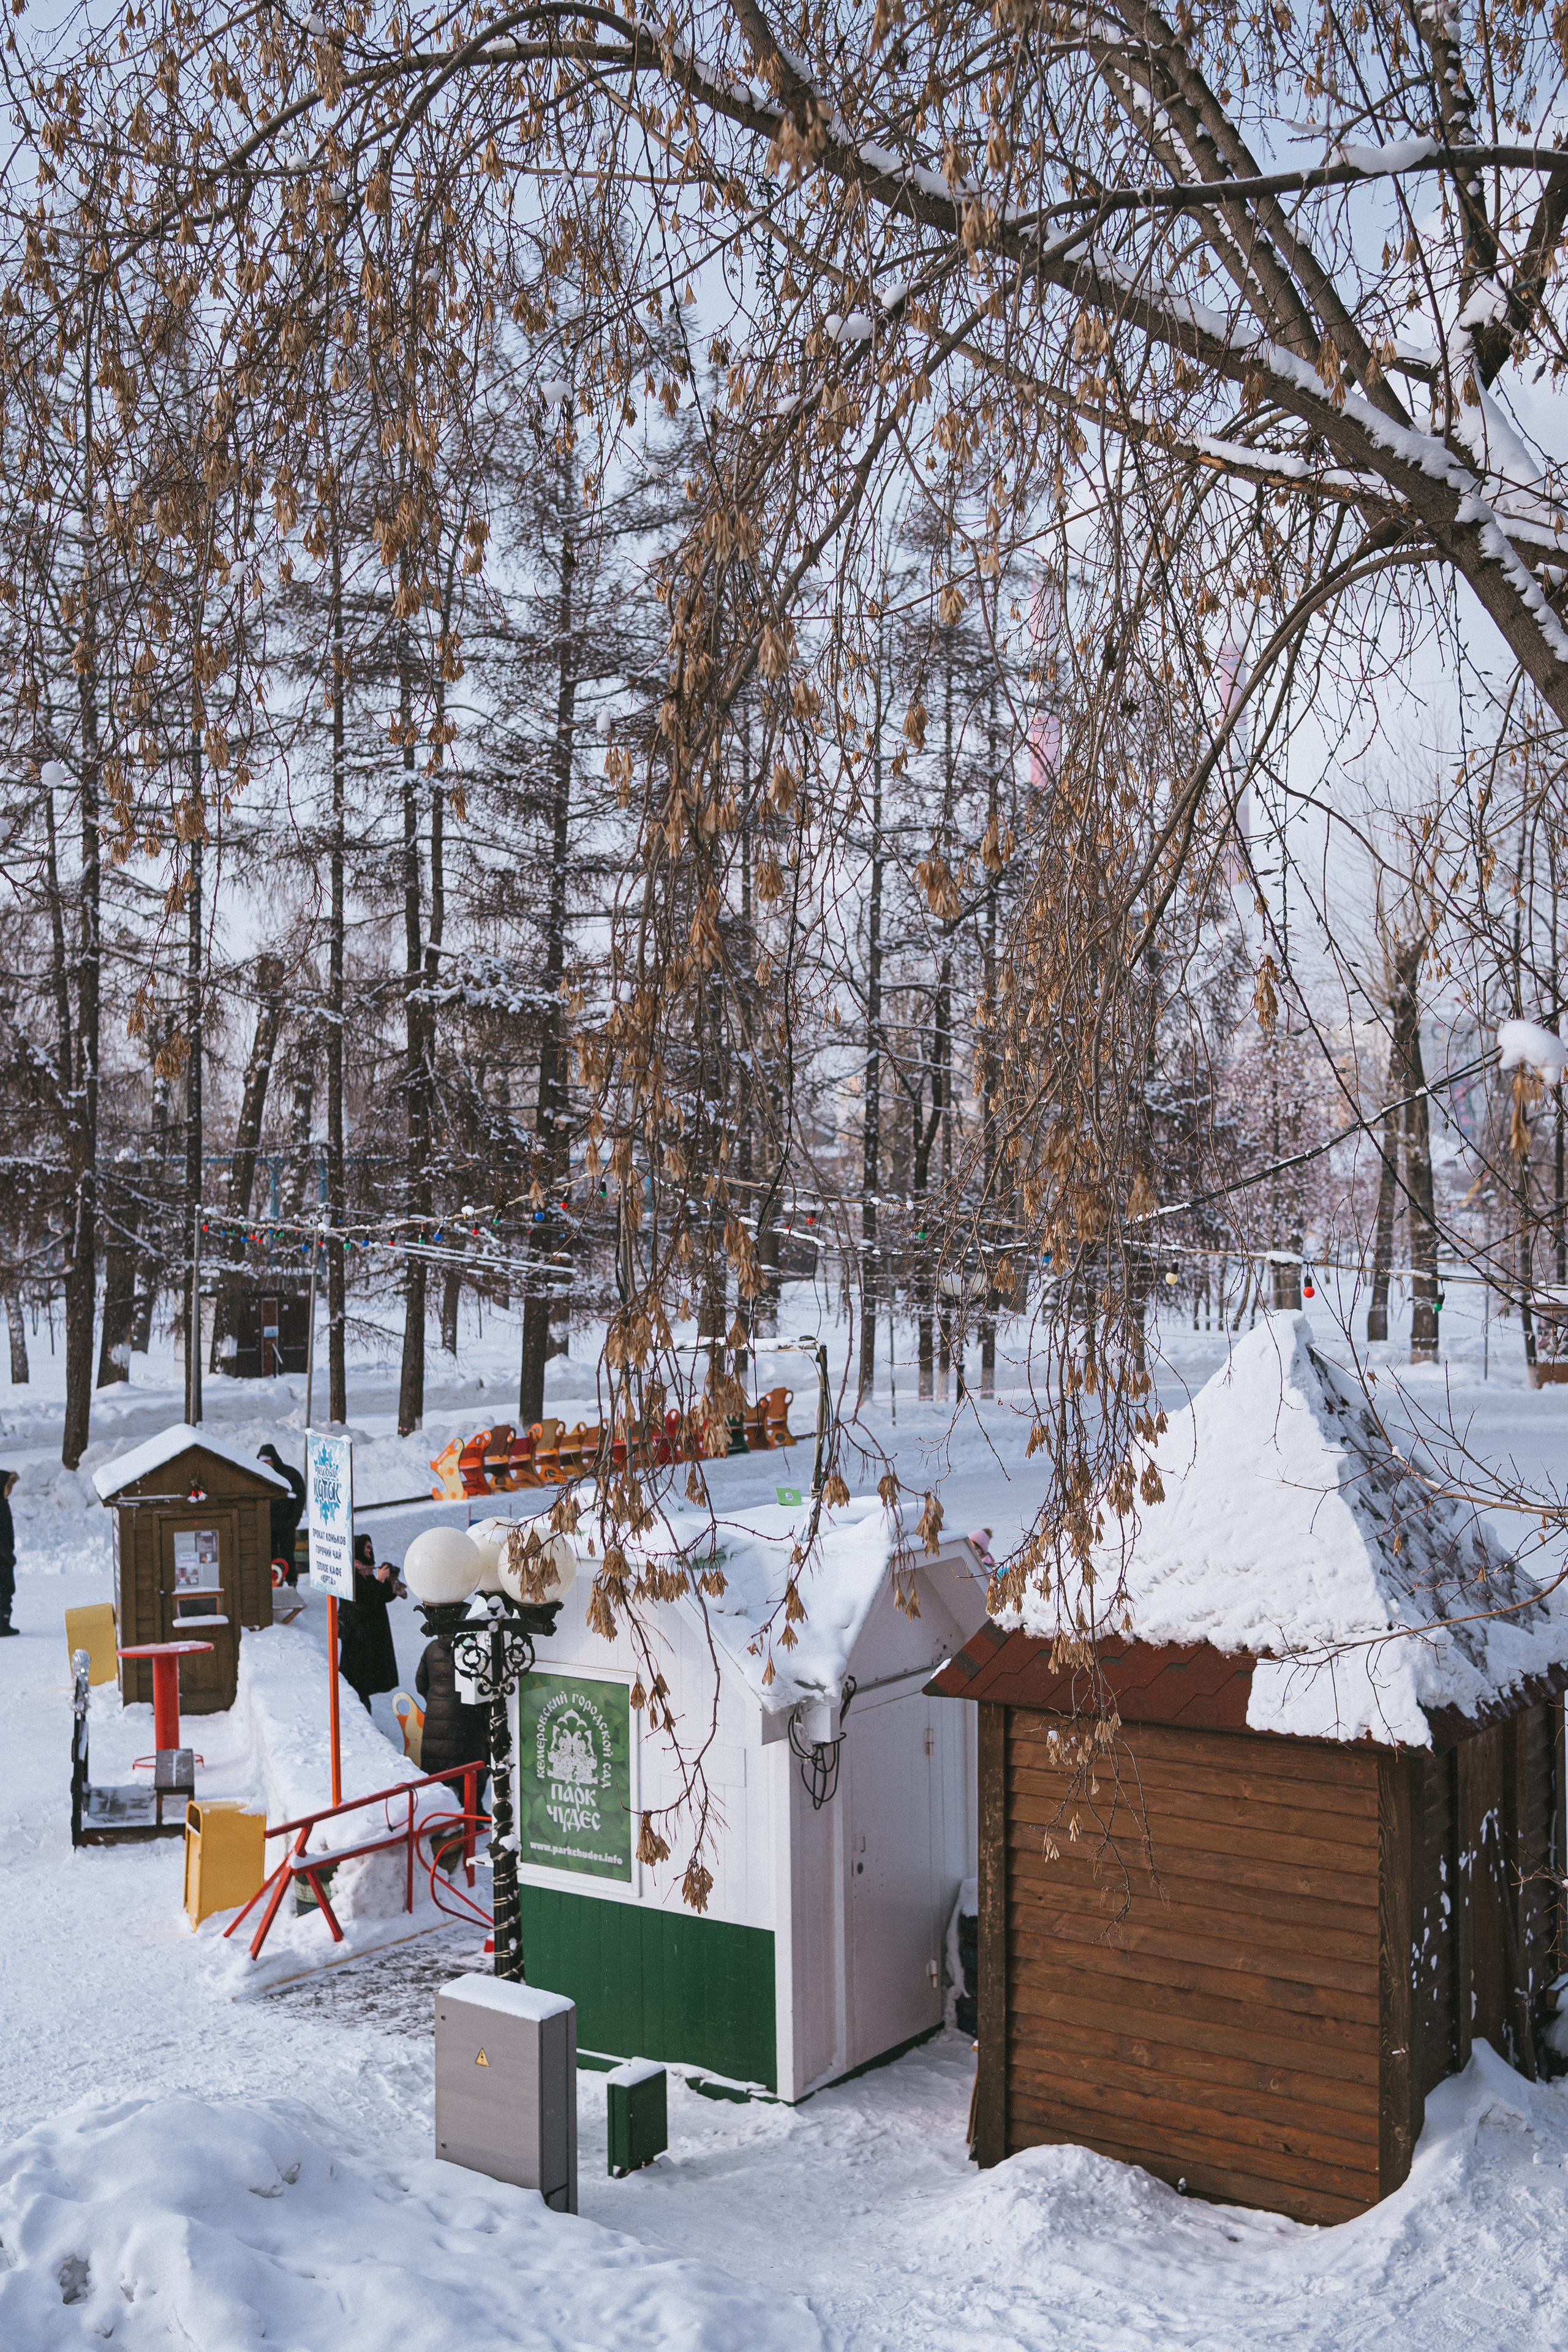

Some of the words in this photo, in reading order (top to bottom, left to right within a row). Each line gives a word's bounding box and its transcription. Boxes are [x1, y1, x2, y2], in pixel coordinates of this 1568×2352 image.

[326, 1532, 346, 1545] КОНЬКОВ
[333, 1548, 342, 1560] ЧАЙ
[330, 1566, 342, 1577] КАФЕ
[529, 1841, 624, 1865] www.parkchudes.info
